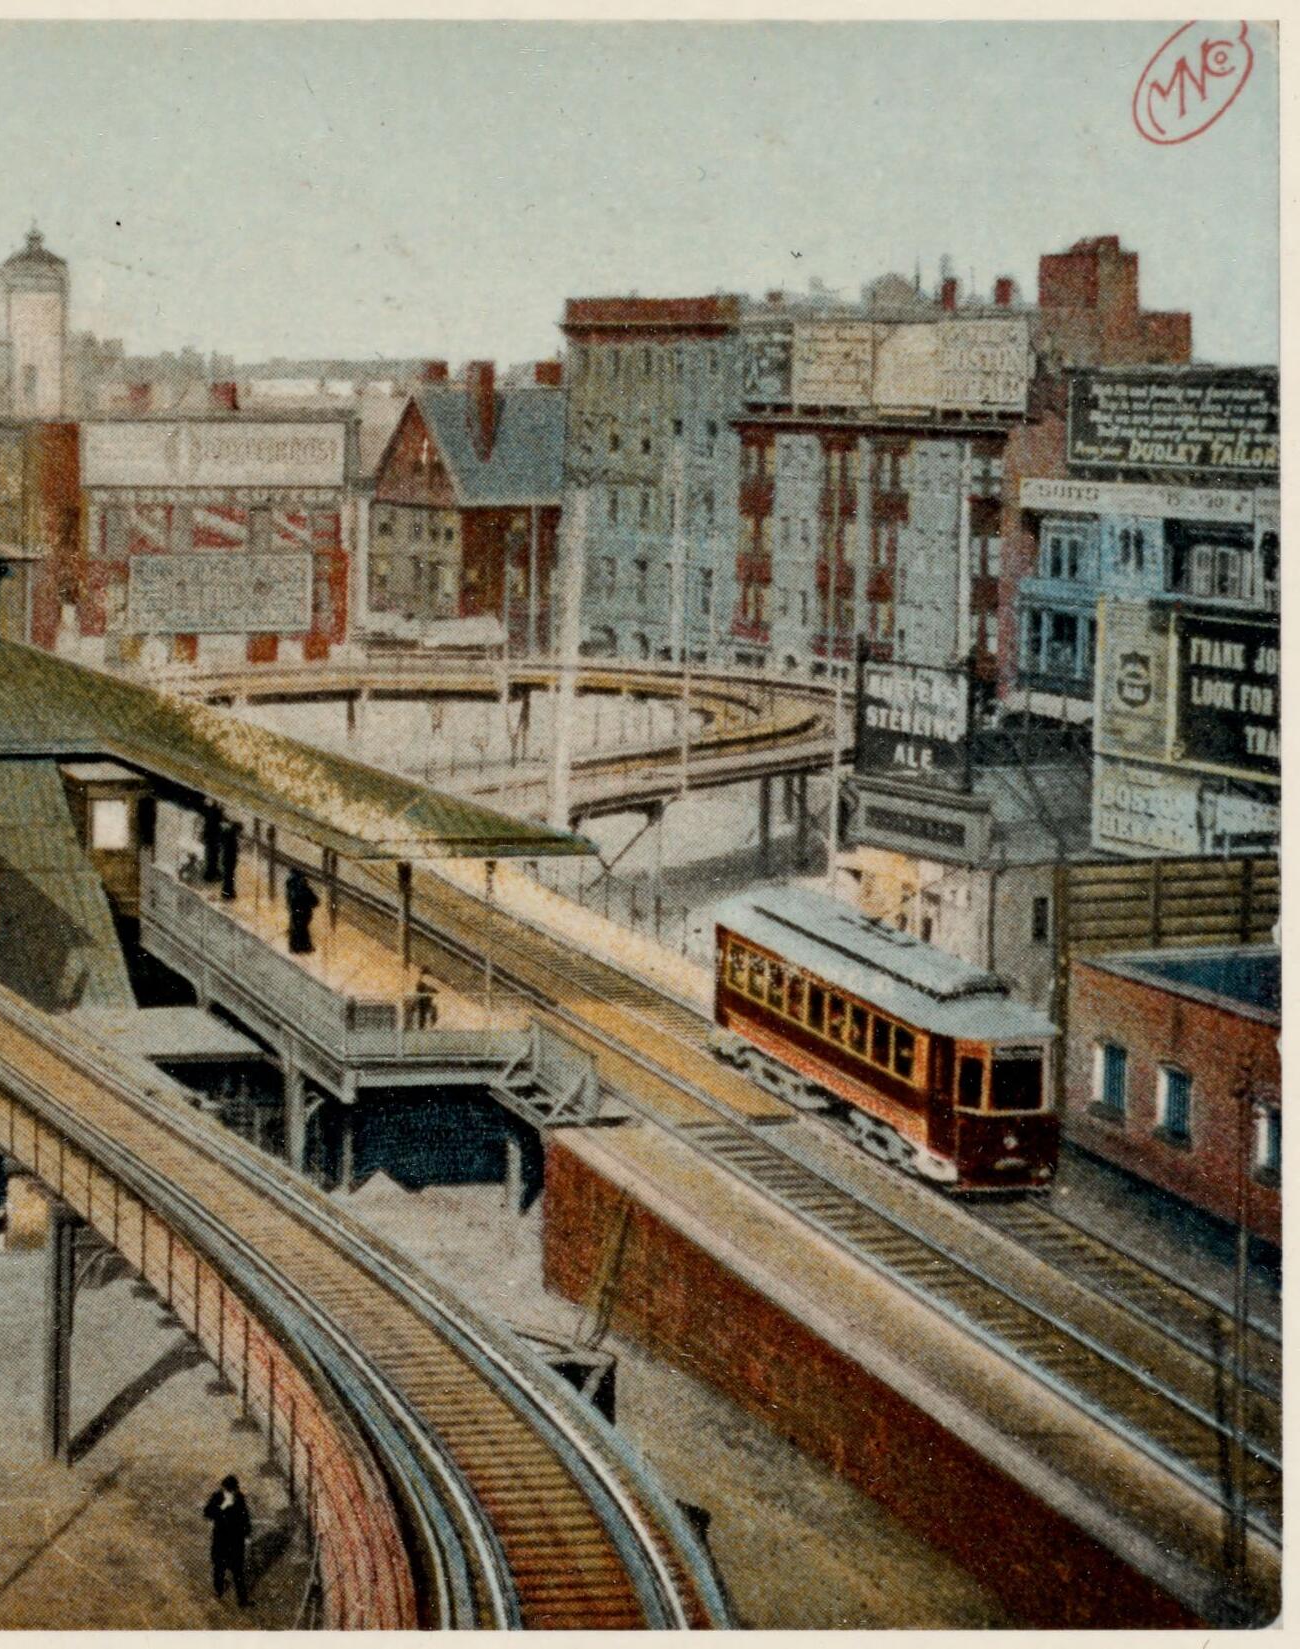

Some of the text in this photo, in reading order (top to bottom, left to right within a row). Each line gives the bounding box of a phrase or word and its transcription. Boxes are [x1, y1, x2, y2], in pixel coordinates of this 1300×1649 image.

[1128, 440, 1202, 464] DUDLEY
[1189, 636, 1281, 675] FRANK JO
[1190, 675, 1274, 716] LOOK FOR
[865, 704, 959, 744] STERLING
[893, 743, 934, 771] ALE
